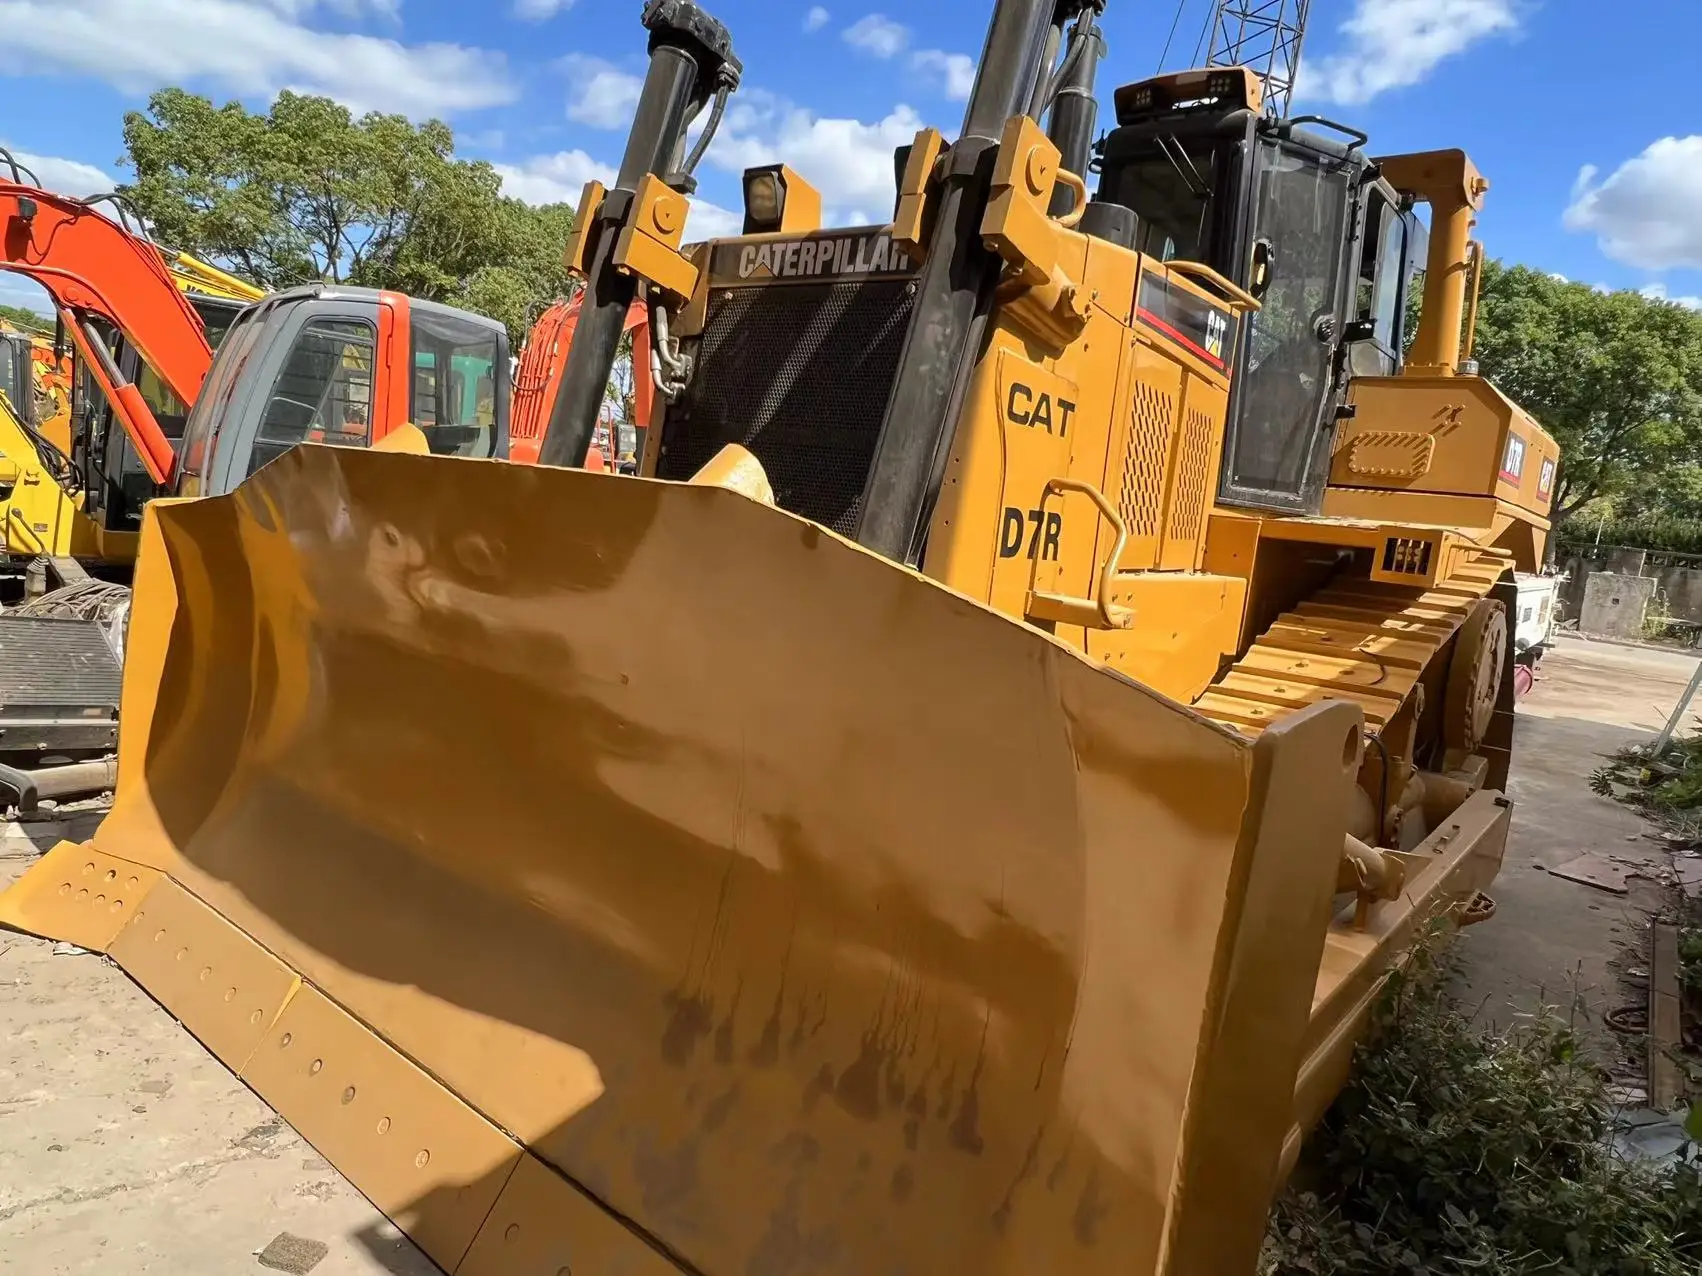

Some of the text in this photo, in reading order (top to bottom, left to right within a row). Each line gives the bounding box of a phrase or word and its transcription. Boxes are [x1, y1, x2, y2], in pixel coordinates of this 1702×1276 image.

[738, 235, 909, 279] CATERPILLAR
[1205, 310, 1227, 358] CAT
[1007, 382, 1076, 438] CAT
[1000, 507, 1061, 561] D7R
